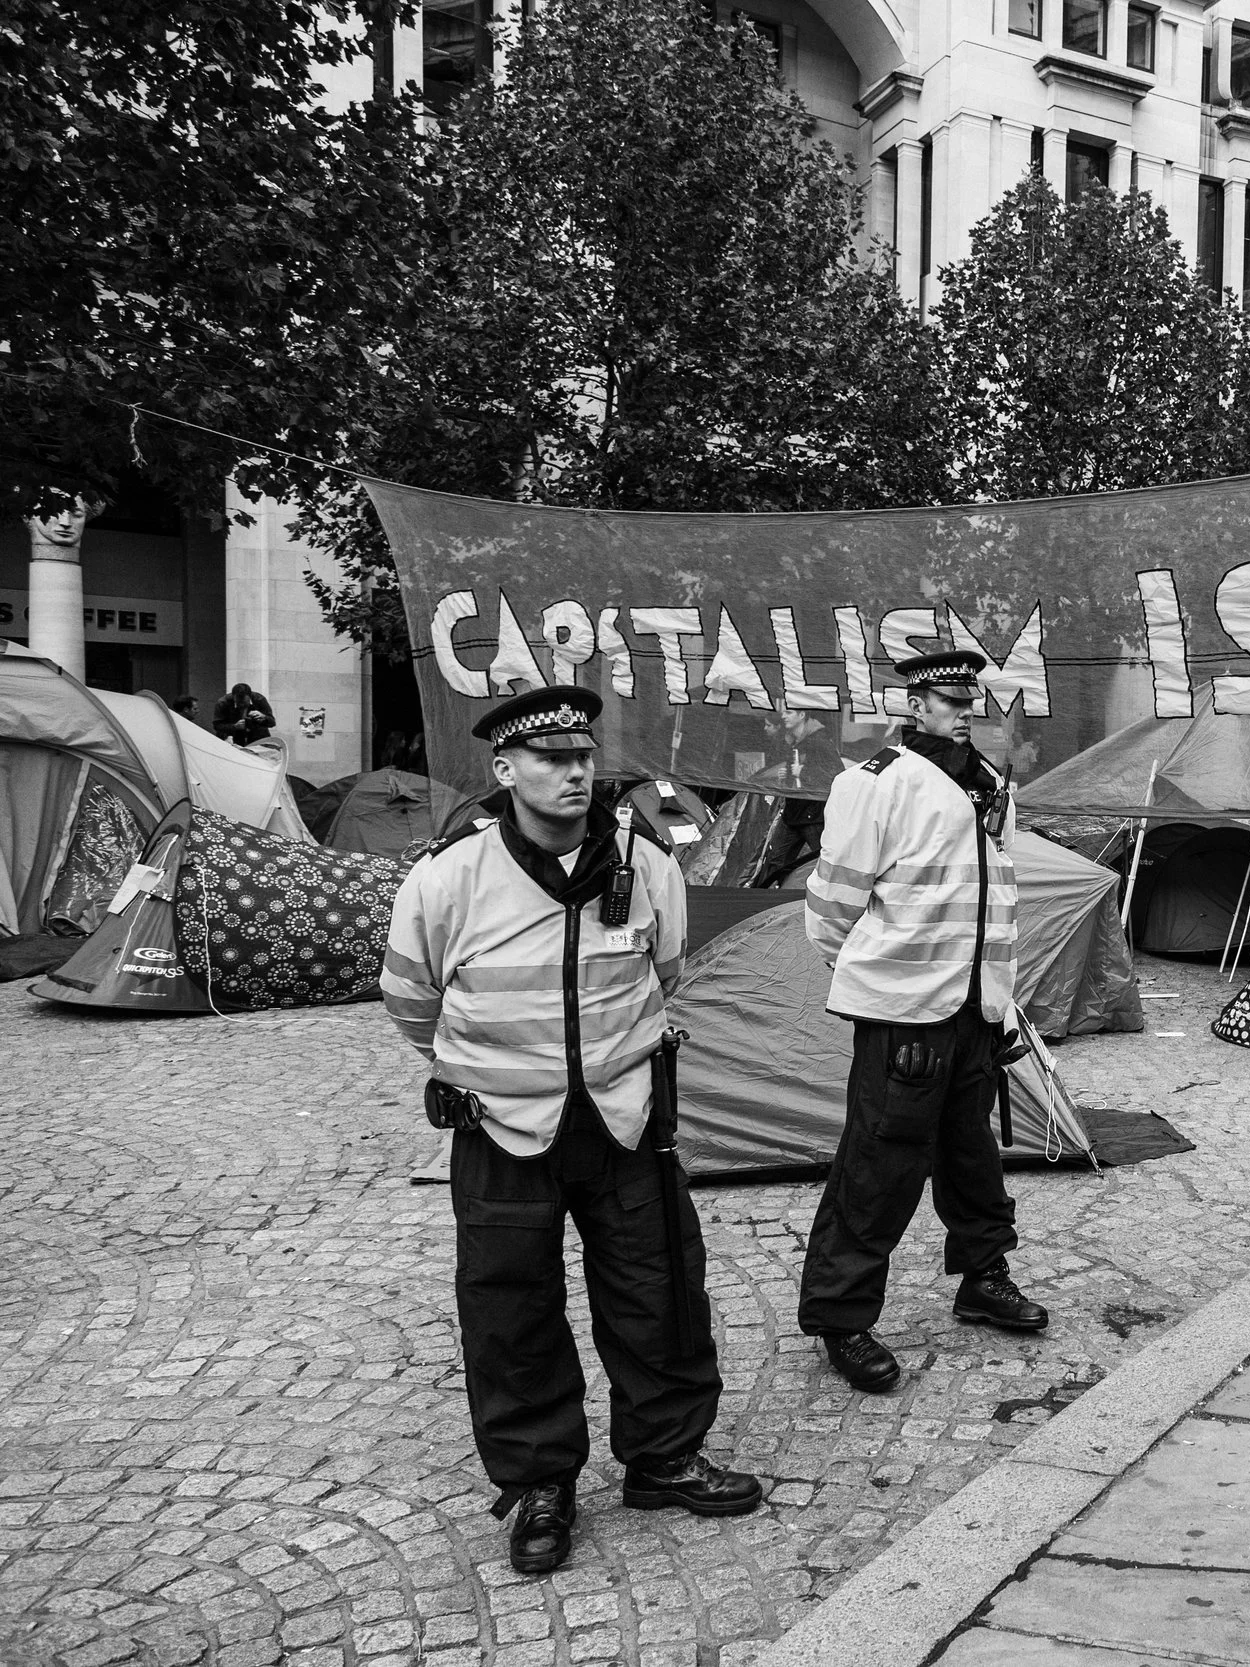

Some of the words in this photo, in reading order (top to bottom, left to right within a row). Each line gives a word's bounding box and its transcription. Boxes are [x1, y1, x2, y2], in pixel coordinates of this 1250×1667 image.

[24, 605, 157, 633] FFEE
[430, 586, 1053, 719] CAPITALISM
[122, 963, 167, 975] QUICKPITCH
